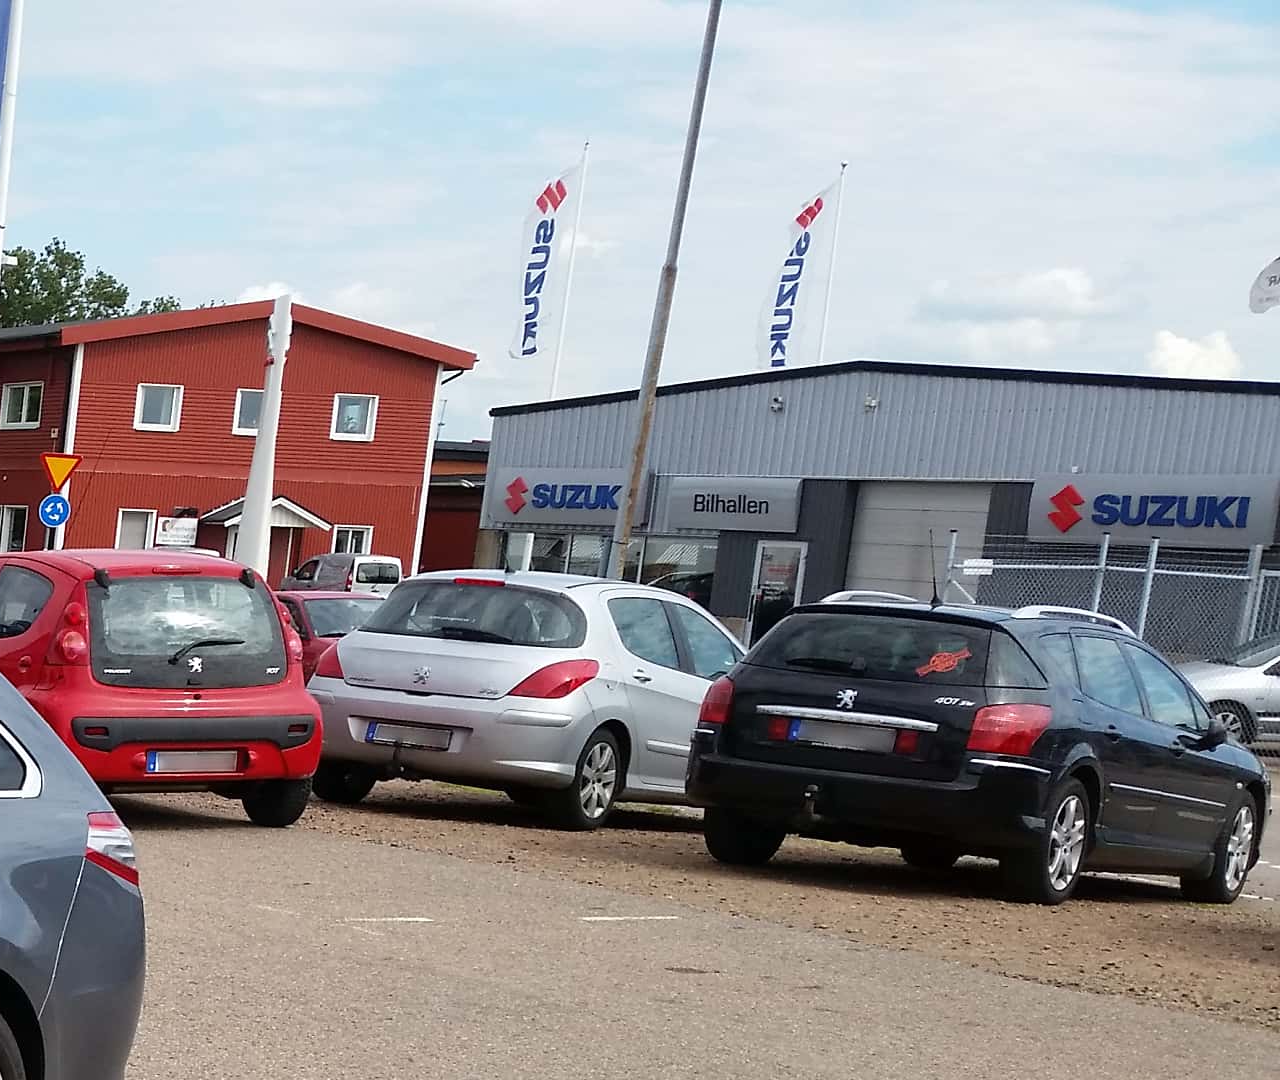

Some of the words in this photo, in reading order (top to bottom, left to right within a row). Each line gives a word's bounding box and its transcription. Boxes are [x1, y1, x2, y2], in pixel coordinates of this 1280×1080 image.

[531, 484, 623, 510] SUZUK
[693, 494, 769, 514] Bilhallen
[1092, 494, 1251, 528] SUZUKI
[934, 697, 960, 705] 407
